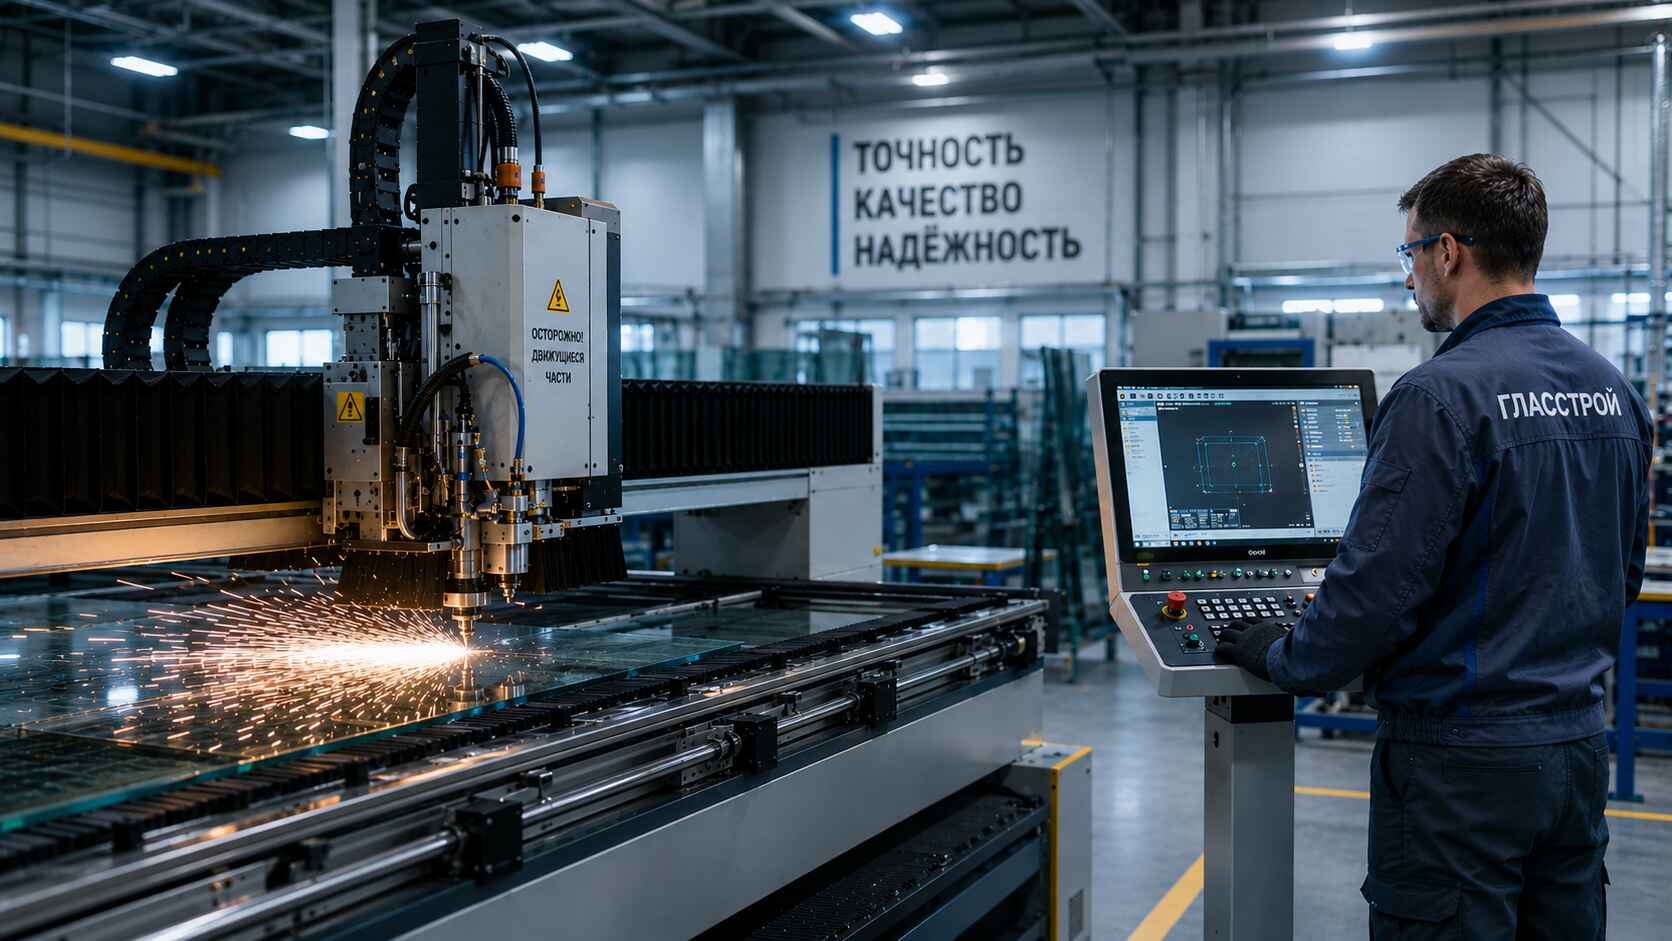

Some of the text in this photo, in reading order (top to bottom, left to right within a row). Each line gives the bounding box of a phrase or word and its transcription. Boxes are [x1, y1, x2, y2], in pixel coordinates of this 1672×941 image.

[853, 132, 1025, 175] ТОЧНОСТЬ
[854, 181, 1023, 221] КАЧЕСТВО
[854, 224, 1082, 271] НАДЁЖНОСТЬ
[531, 327, 584, 344] ОСТОРОЖНО!
[531, 349, 585, 365] ДВИЖУЩИЕСЯ
[545, 371, 571, 384] ЧАСТИ
[1497, 387, 1622, 420] ГЛАССТРОЙ
